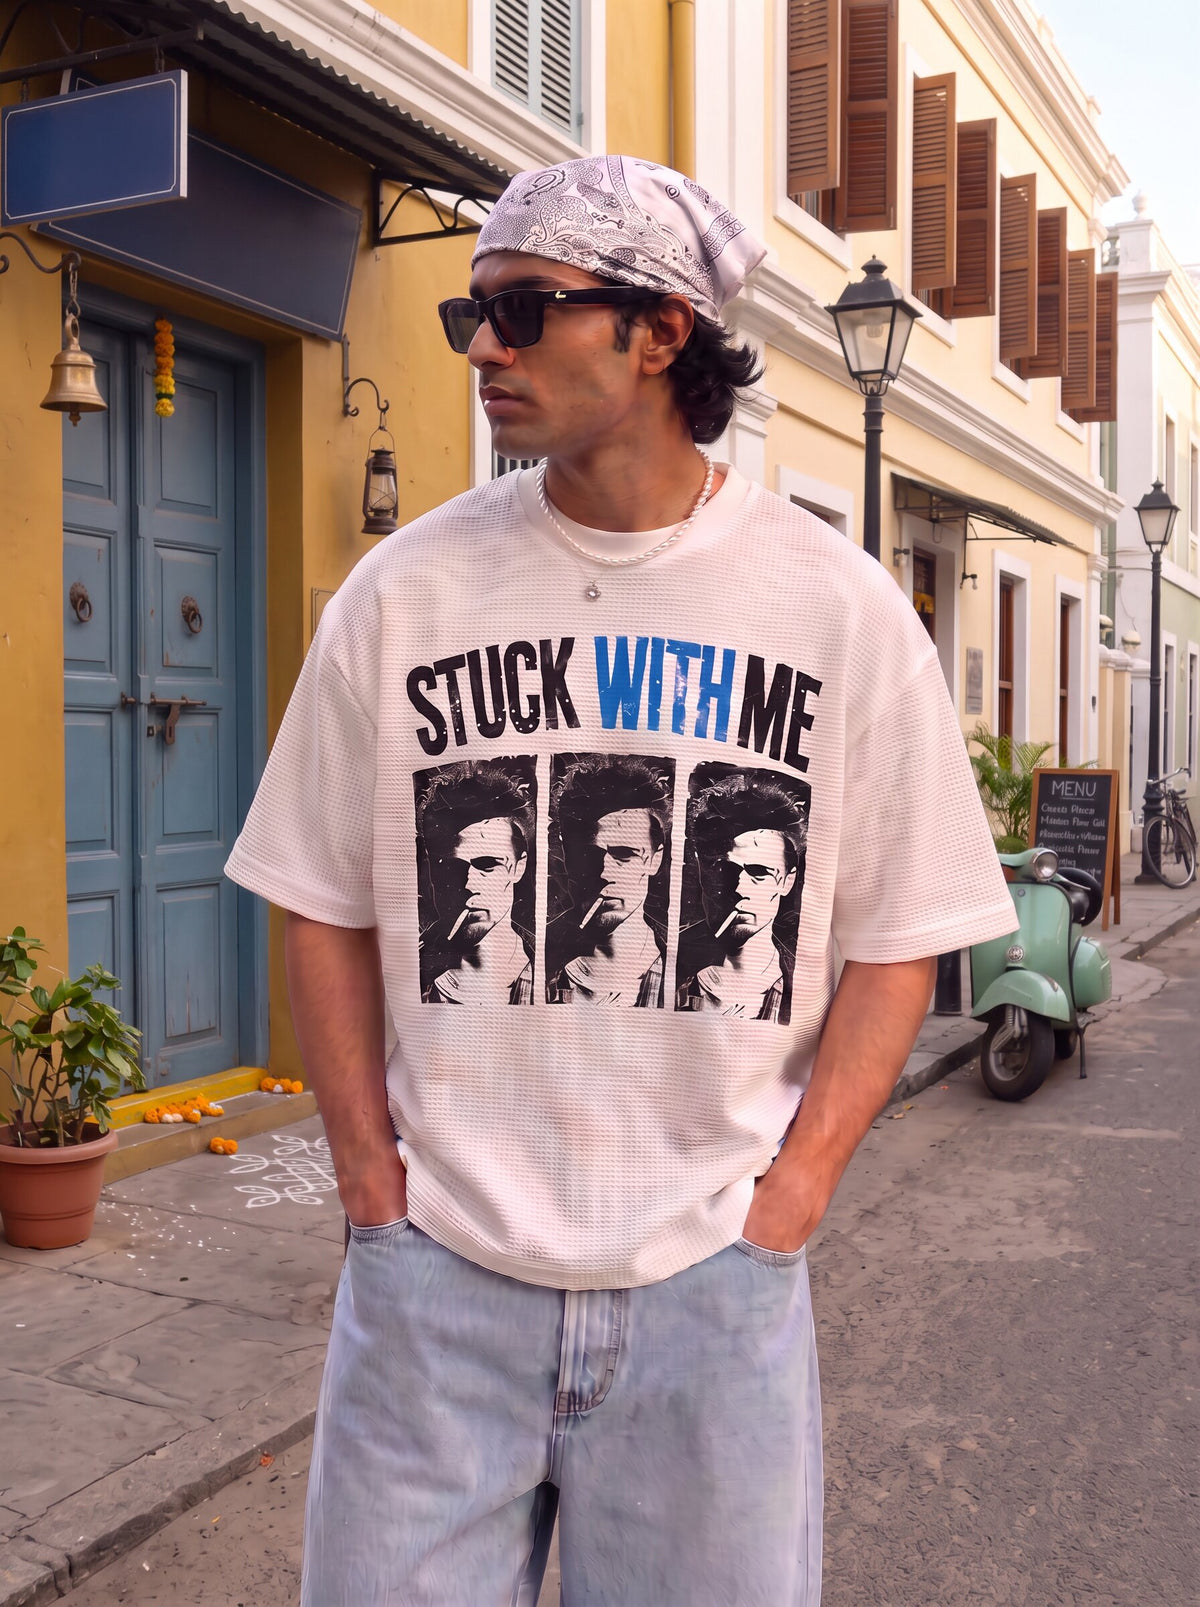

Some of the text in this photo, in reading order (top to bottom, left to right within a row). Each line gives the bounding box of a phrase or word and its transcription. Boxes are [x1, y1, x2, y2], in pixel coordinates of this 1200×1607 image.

[406, 636, 823, 773] STUCK WITH ME
[1051, 780, 1097, 797] MENU
